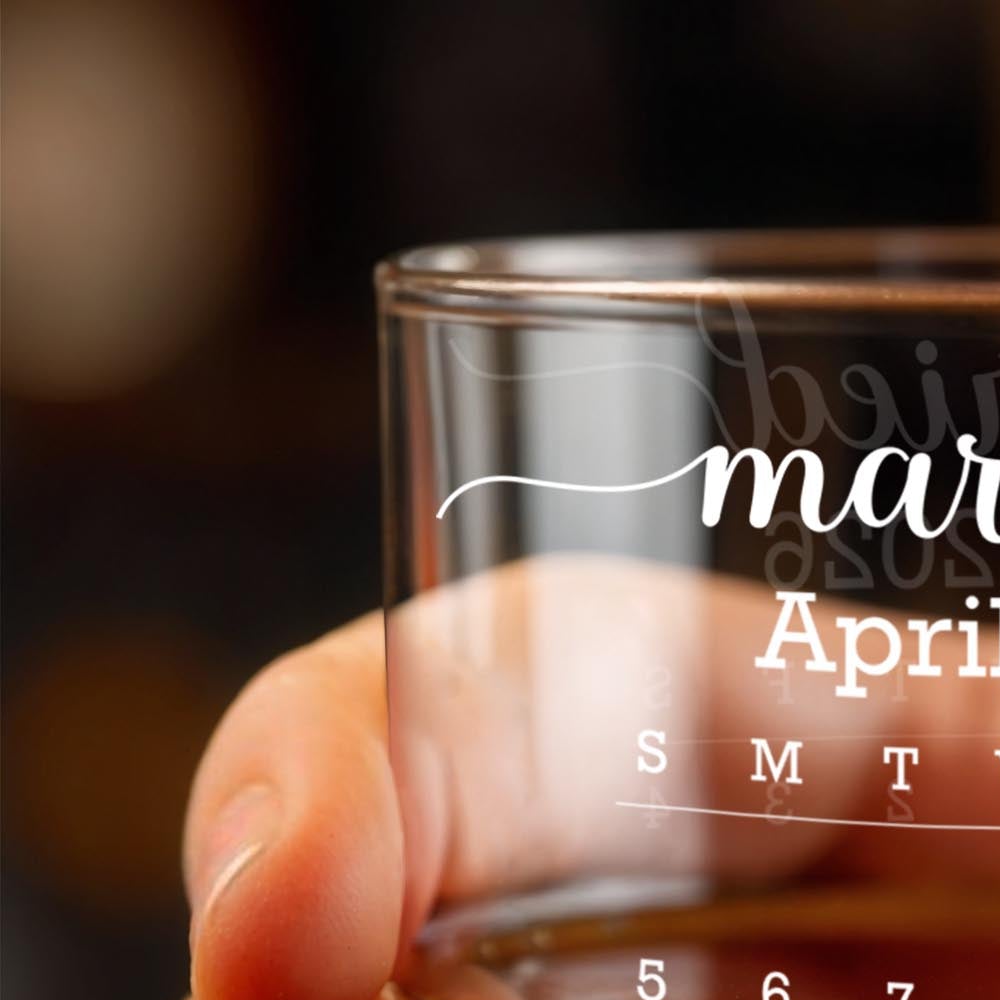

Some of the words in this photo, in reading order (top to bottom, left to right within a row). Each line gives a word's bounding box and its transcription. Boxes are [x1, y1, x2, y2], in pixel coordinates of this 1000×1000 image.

[637, 729, 668, 774] S
[751, 739, 803, 784] M
[883, 747, 919, 791] T
